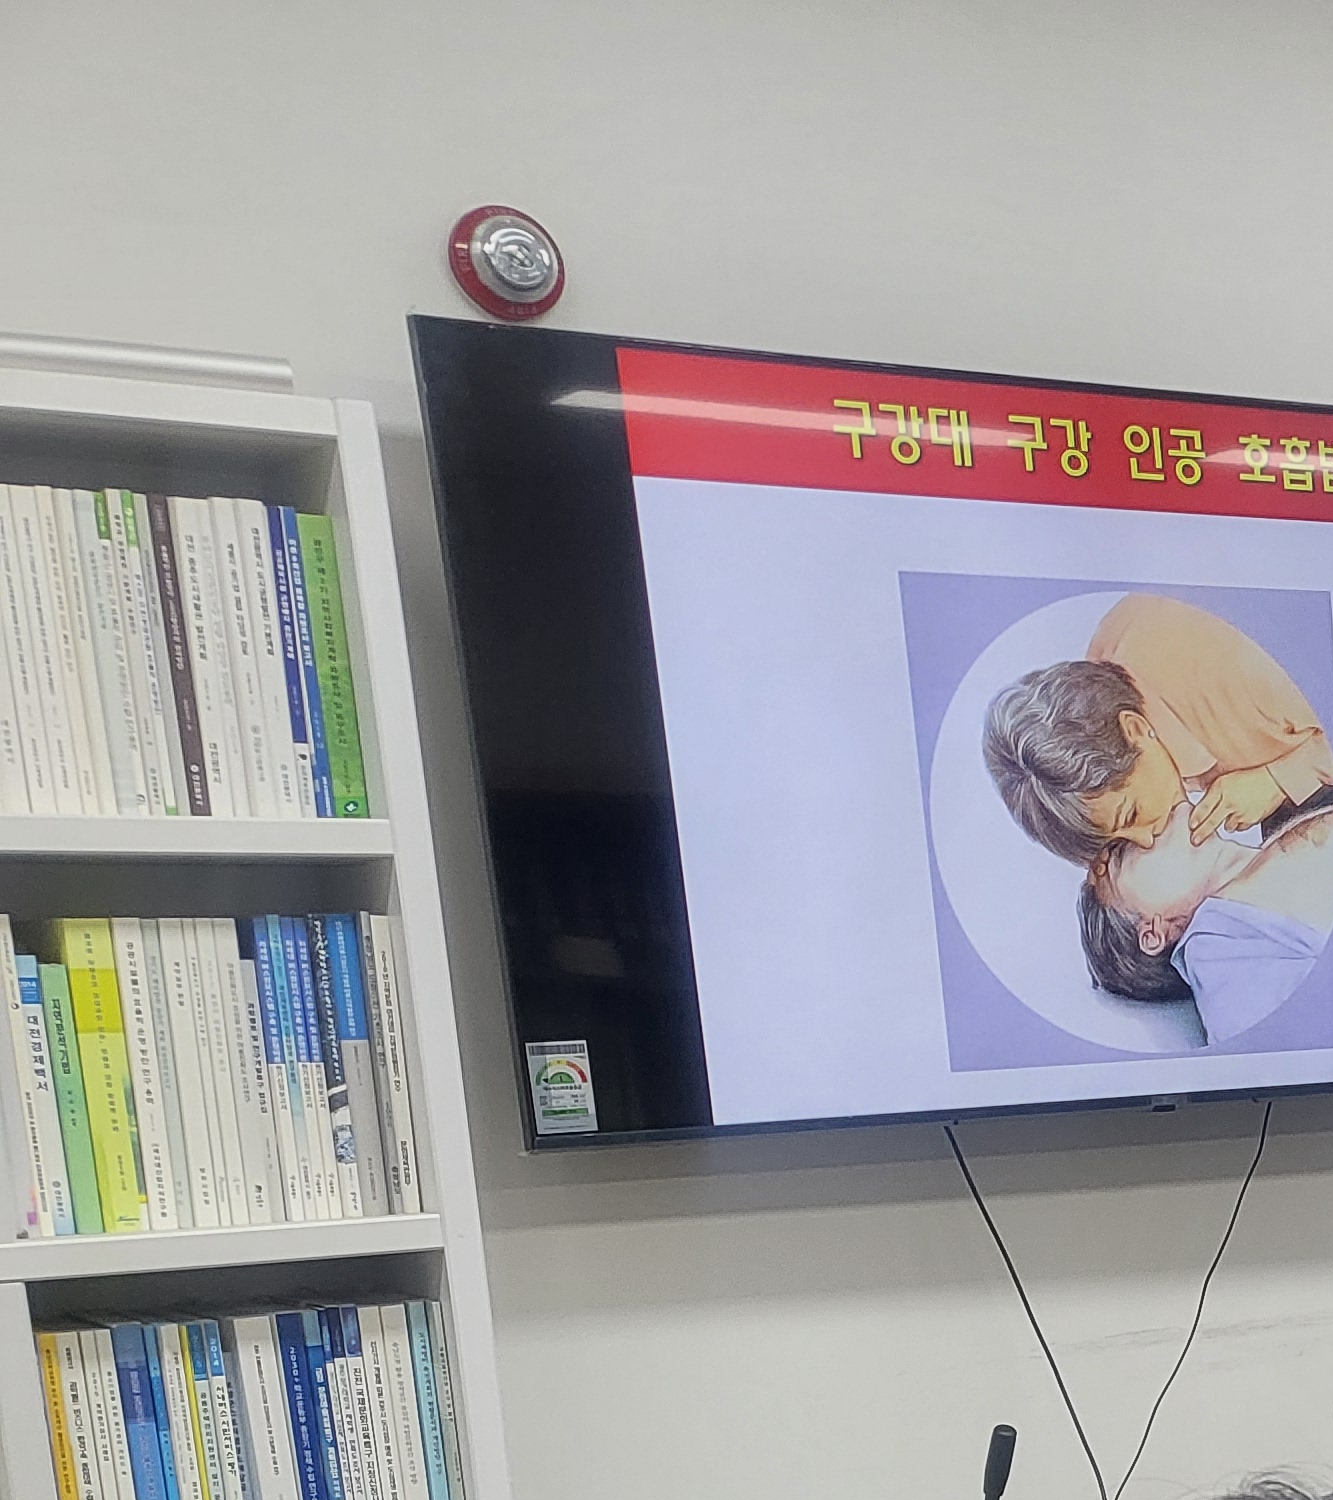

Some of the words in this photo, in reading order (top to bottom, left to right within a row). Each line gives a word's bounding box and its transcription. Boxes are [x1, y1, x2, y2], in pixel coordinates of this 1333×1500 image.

[833, 399, 973, 467] 구강대
[1007, 414, 1093, 477] 구강
[1123, 424, 1207, 485] 인공
